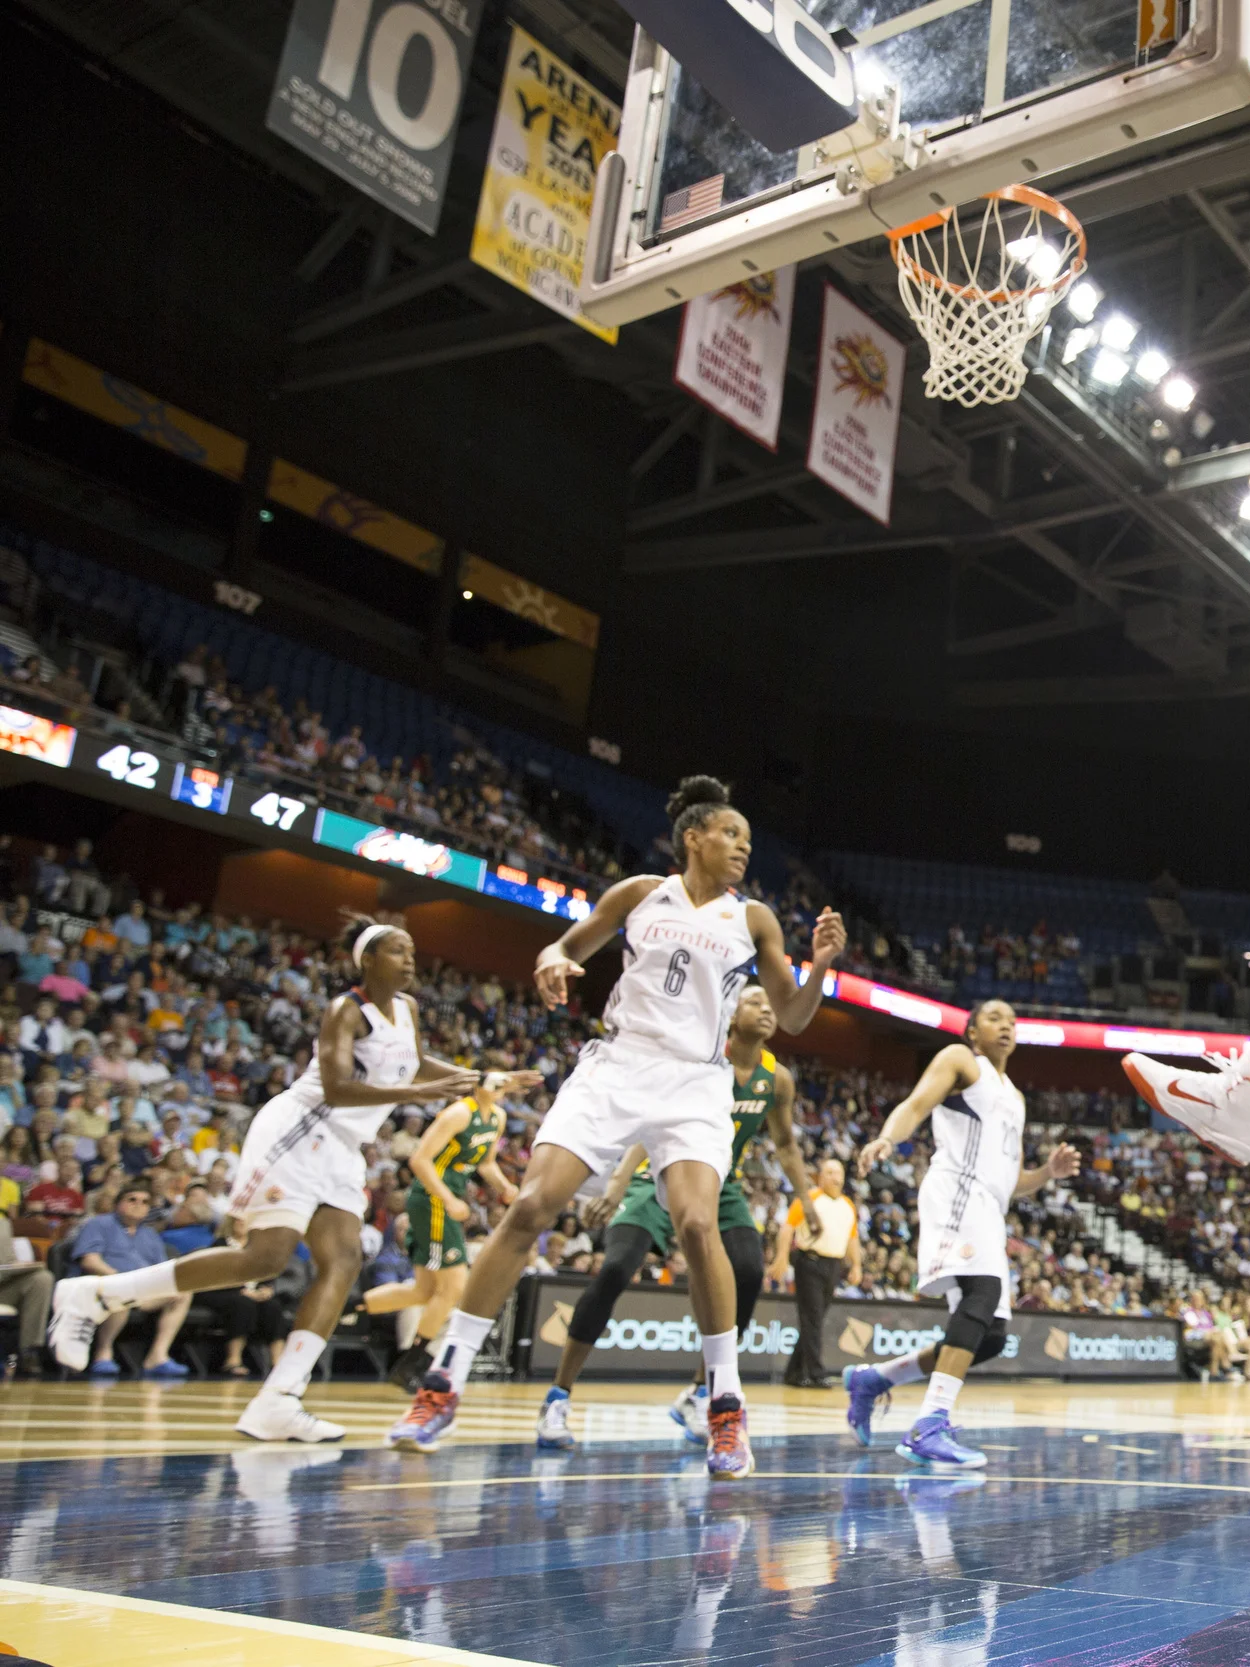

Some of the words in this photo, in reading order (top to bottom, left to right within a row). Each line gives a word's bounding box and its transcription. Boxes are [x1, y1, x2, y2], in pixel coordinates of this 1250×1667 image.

[318, 0, 462, 151] 10
[520, 50, 619, 136] AREN
[288, 75, 337, 117] SOLD
[336, 108, 375, 143] OUT
[515, 85, 597, 174] YEA
[505, 199, 586, 264] ACADE
[97, 745, 160, 789] 42
[250, 792, 306, 831] 47
[642, 919, 735, 959] frontier
[663, 948, 691, 997] 6
